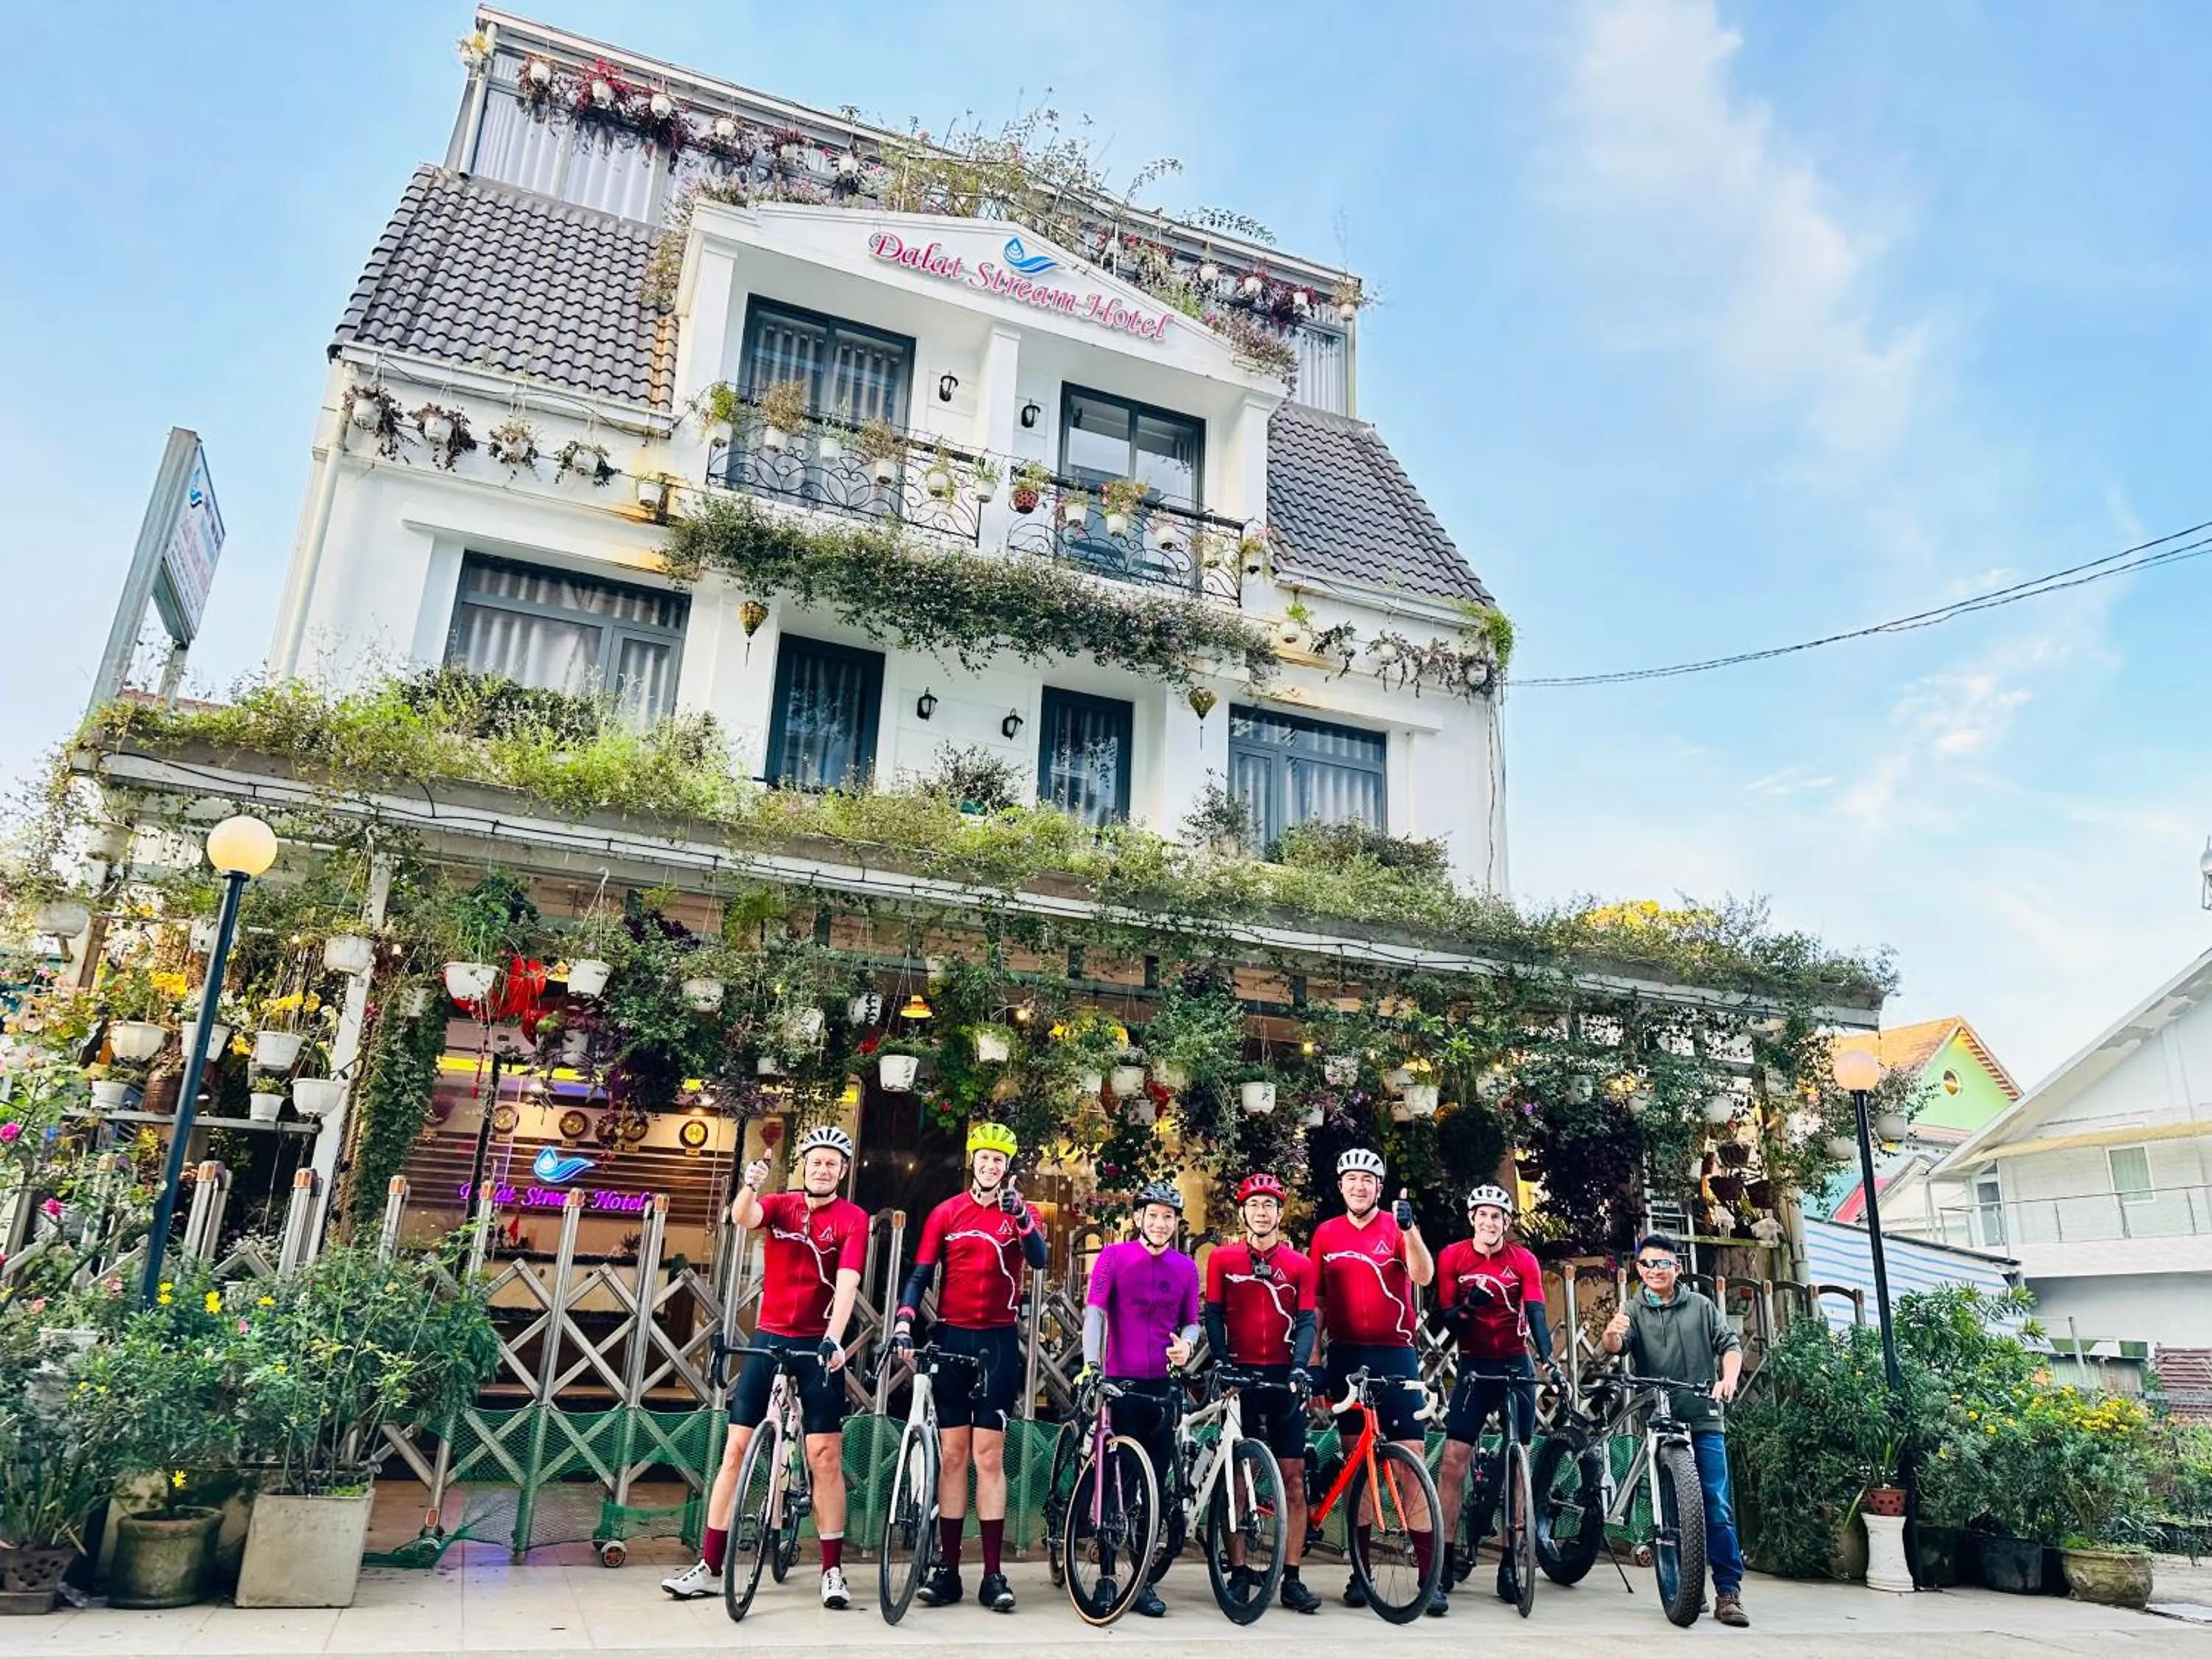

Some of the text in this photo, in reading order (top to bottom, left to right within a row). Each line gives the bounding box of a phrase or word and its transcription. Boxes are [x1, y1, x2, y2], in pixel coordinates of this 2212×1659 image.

[868, 231, 1175, 340] Dalat Stream Hotel
[521, 1186, 585, 1206] Strea
[591, 1190, 650, 1211] Hotel
